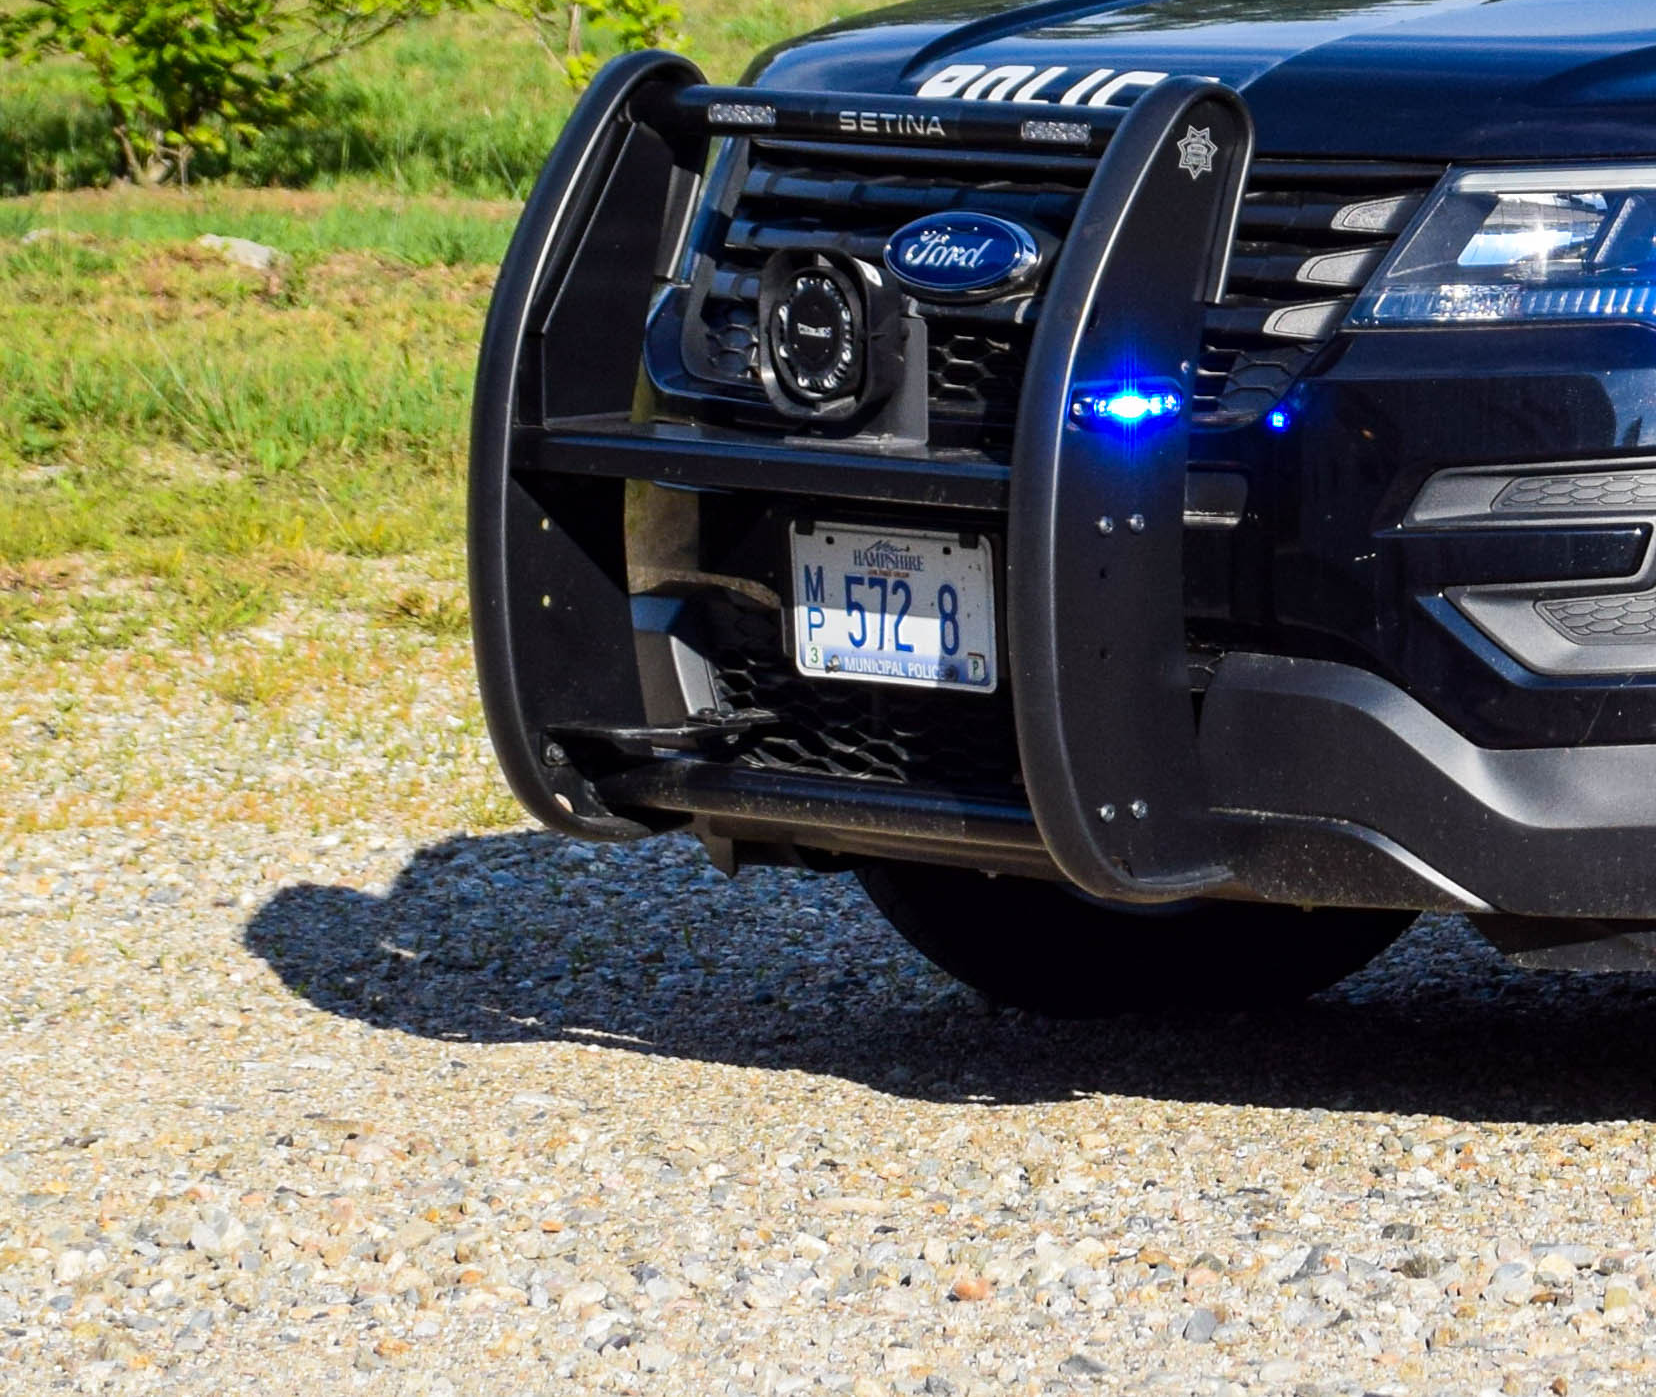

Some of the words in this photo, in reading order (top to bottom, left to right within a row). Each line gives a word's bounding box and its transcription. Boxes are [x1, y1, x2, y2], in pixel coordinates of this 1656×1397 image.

[839, 111, 946, 137] SETINA
[904, 229, 994, 268] Ford
[853, 549, 925, 572] HAMPSHIRE
[804, 564, 825, 603] M
[844, 574, 914, 653] 572
[937, 583, 961, 656] 8
[807, 606, 825, 642] P
[844, 656, 905, 676] MUNICIPAL
